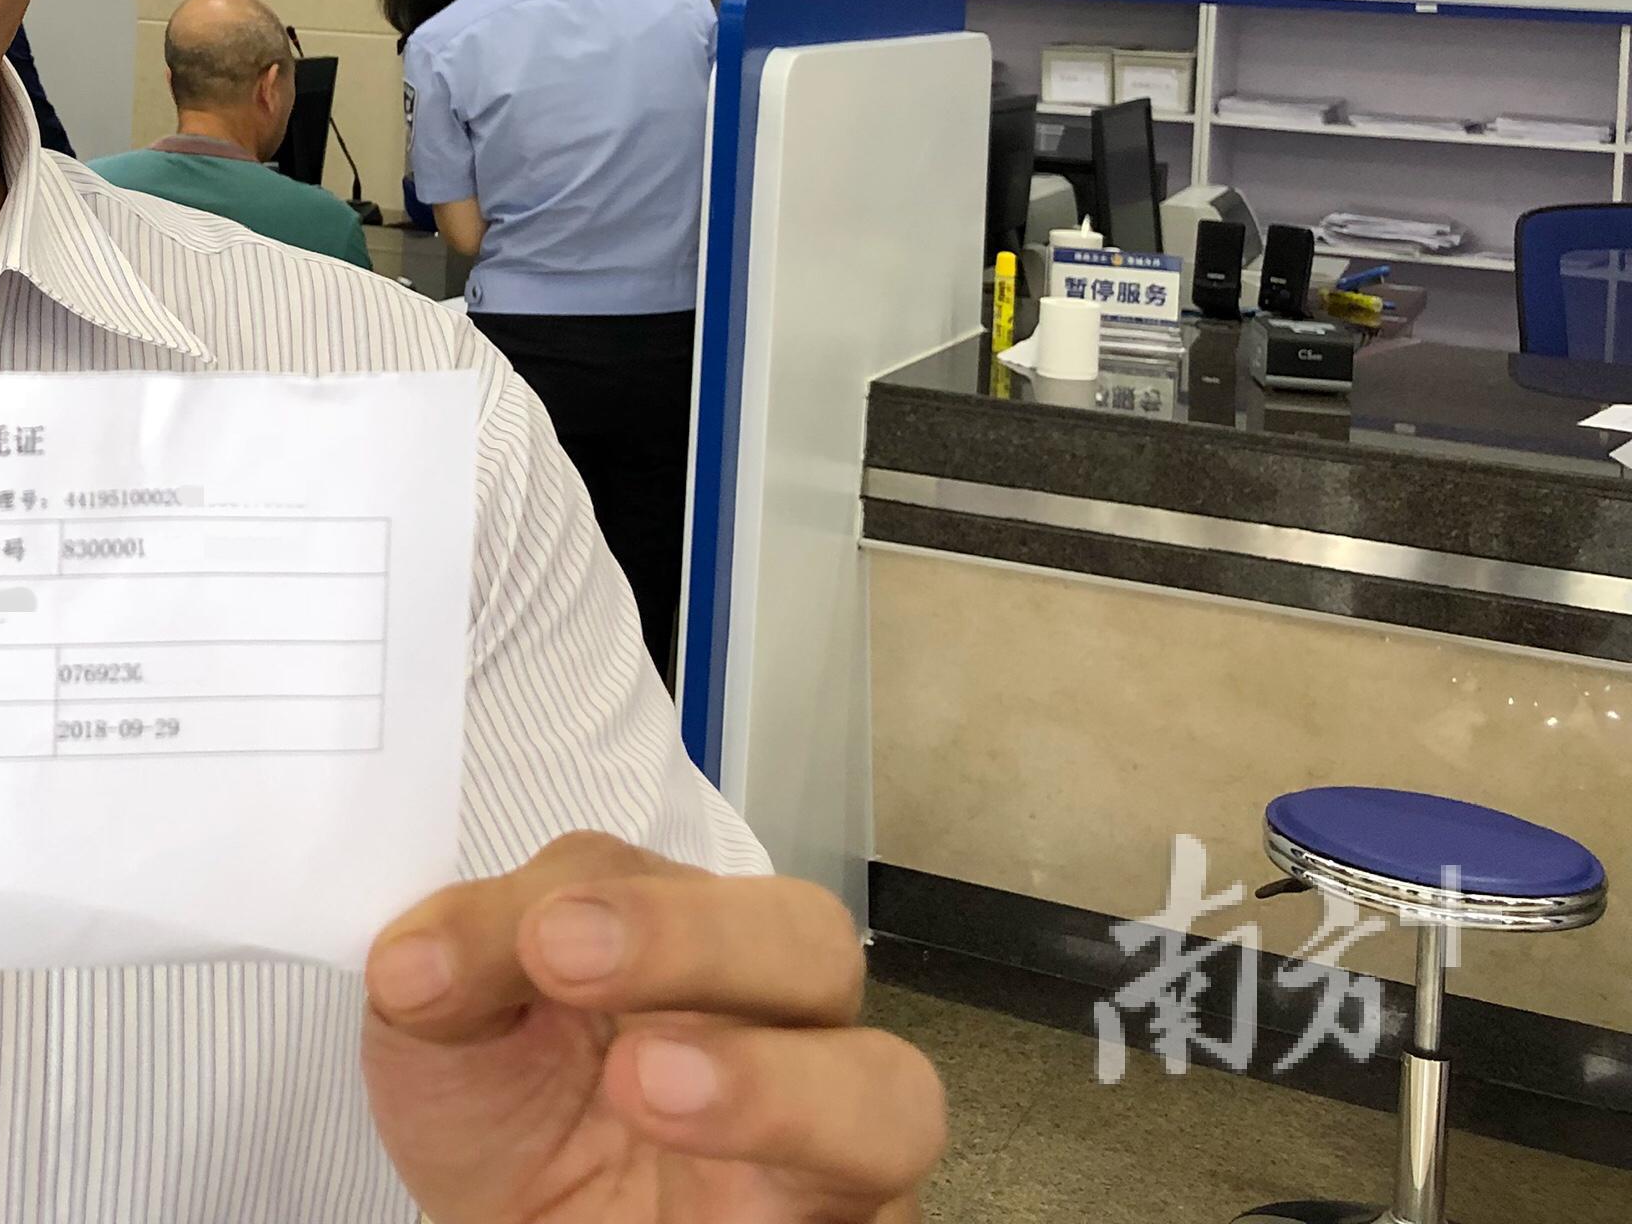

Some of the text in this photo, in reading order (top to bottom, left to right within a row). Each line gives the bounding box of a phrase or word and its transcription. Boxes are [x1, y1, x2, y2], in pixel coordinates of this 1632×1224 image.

[1065, 277, 1167, 306] 暂停服务
[56, 717, 181, 741] 2018-09-29
